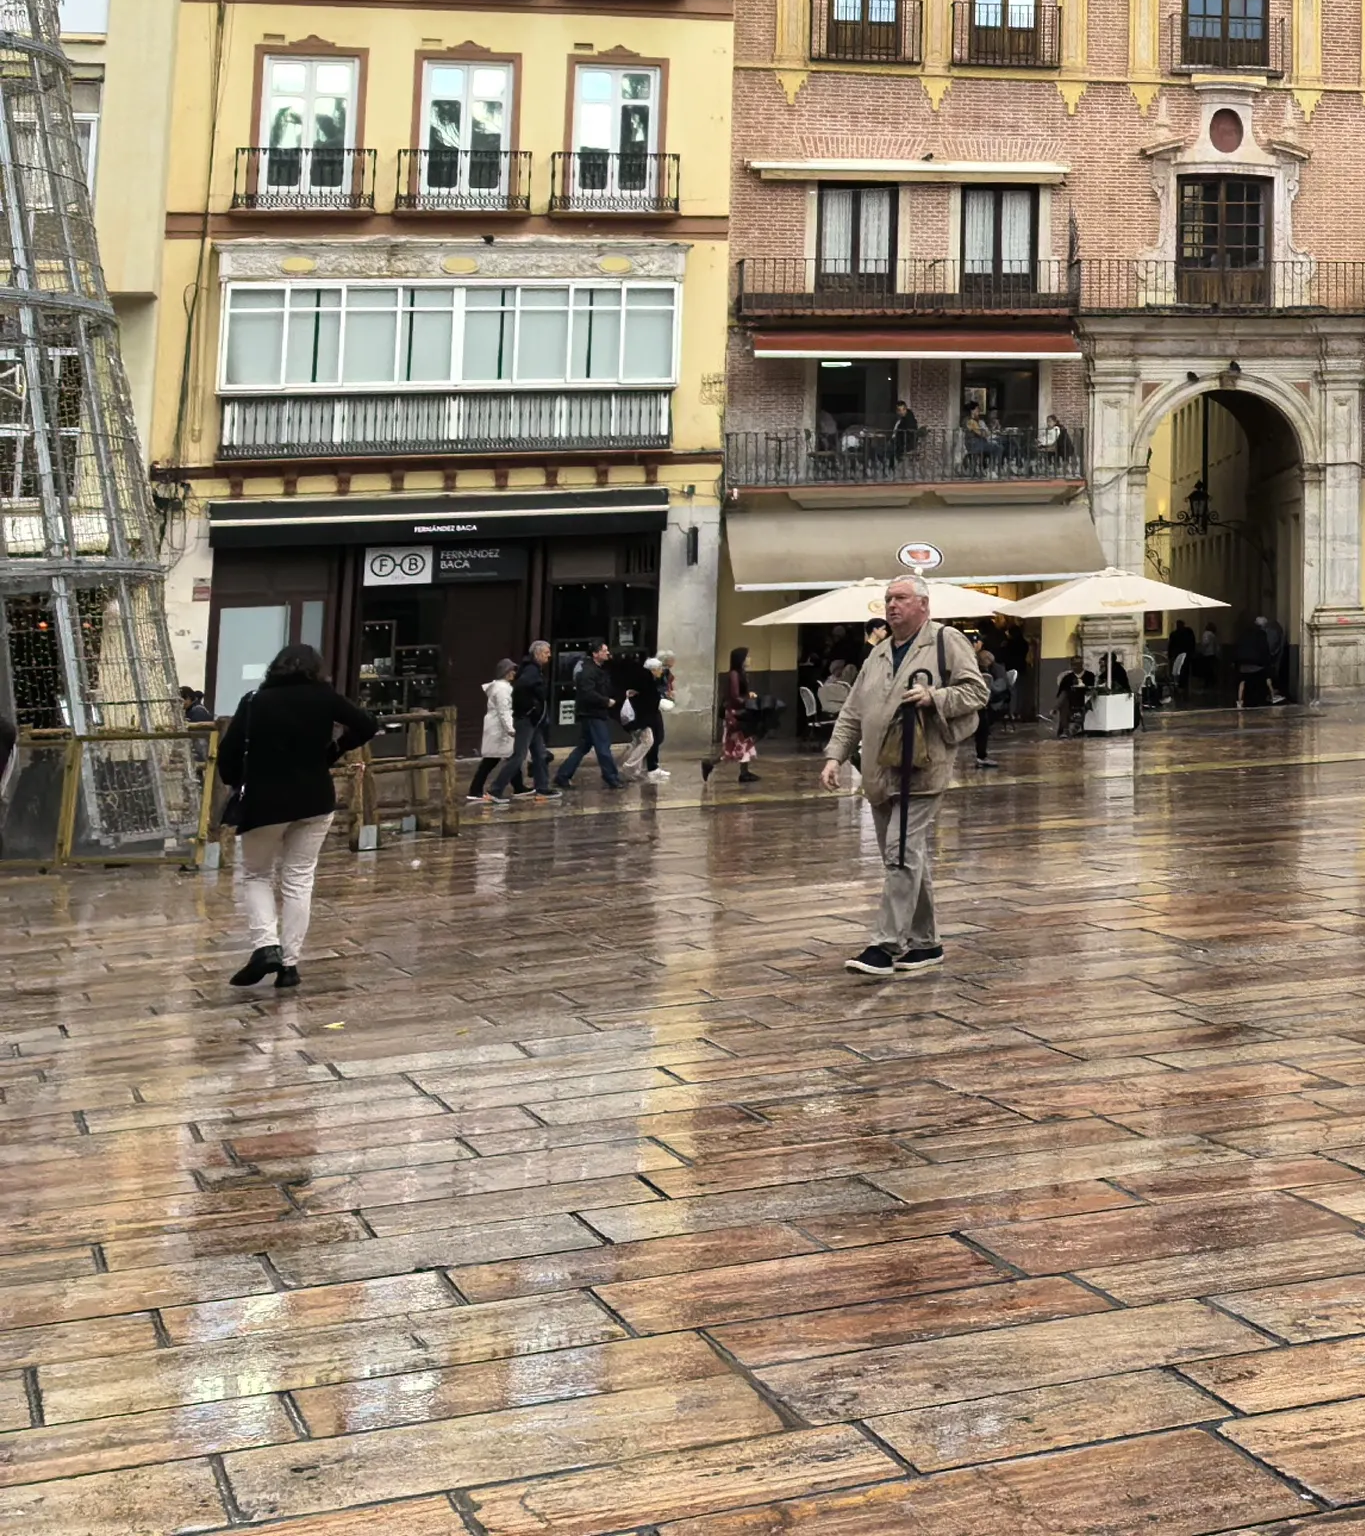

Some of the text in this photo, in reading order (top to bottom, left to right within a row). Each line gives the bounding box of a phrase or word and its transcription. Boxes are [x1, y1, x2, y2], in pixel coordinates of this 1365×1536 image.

[379, 558, 418, 572] F B
[440, 560, 470, 569] BACA
